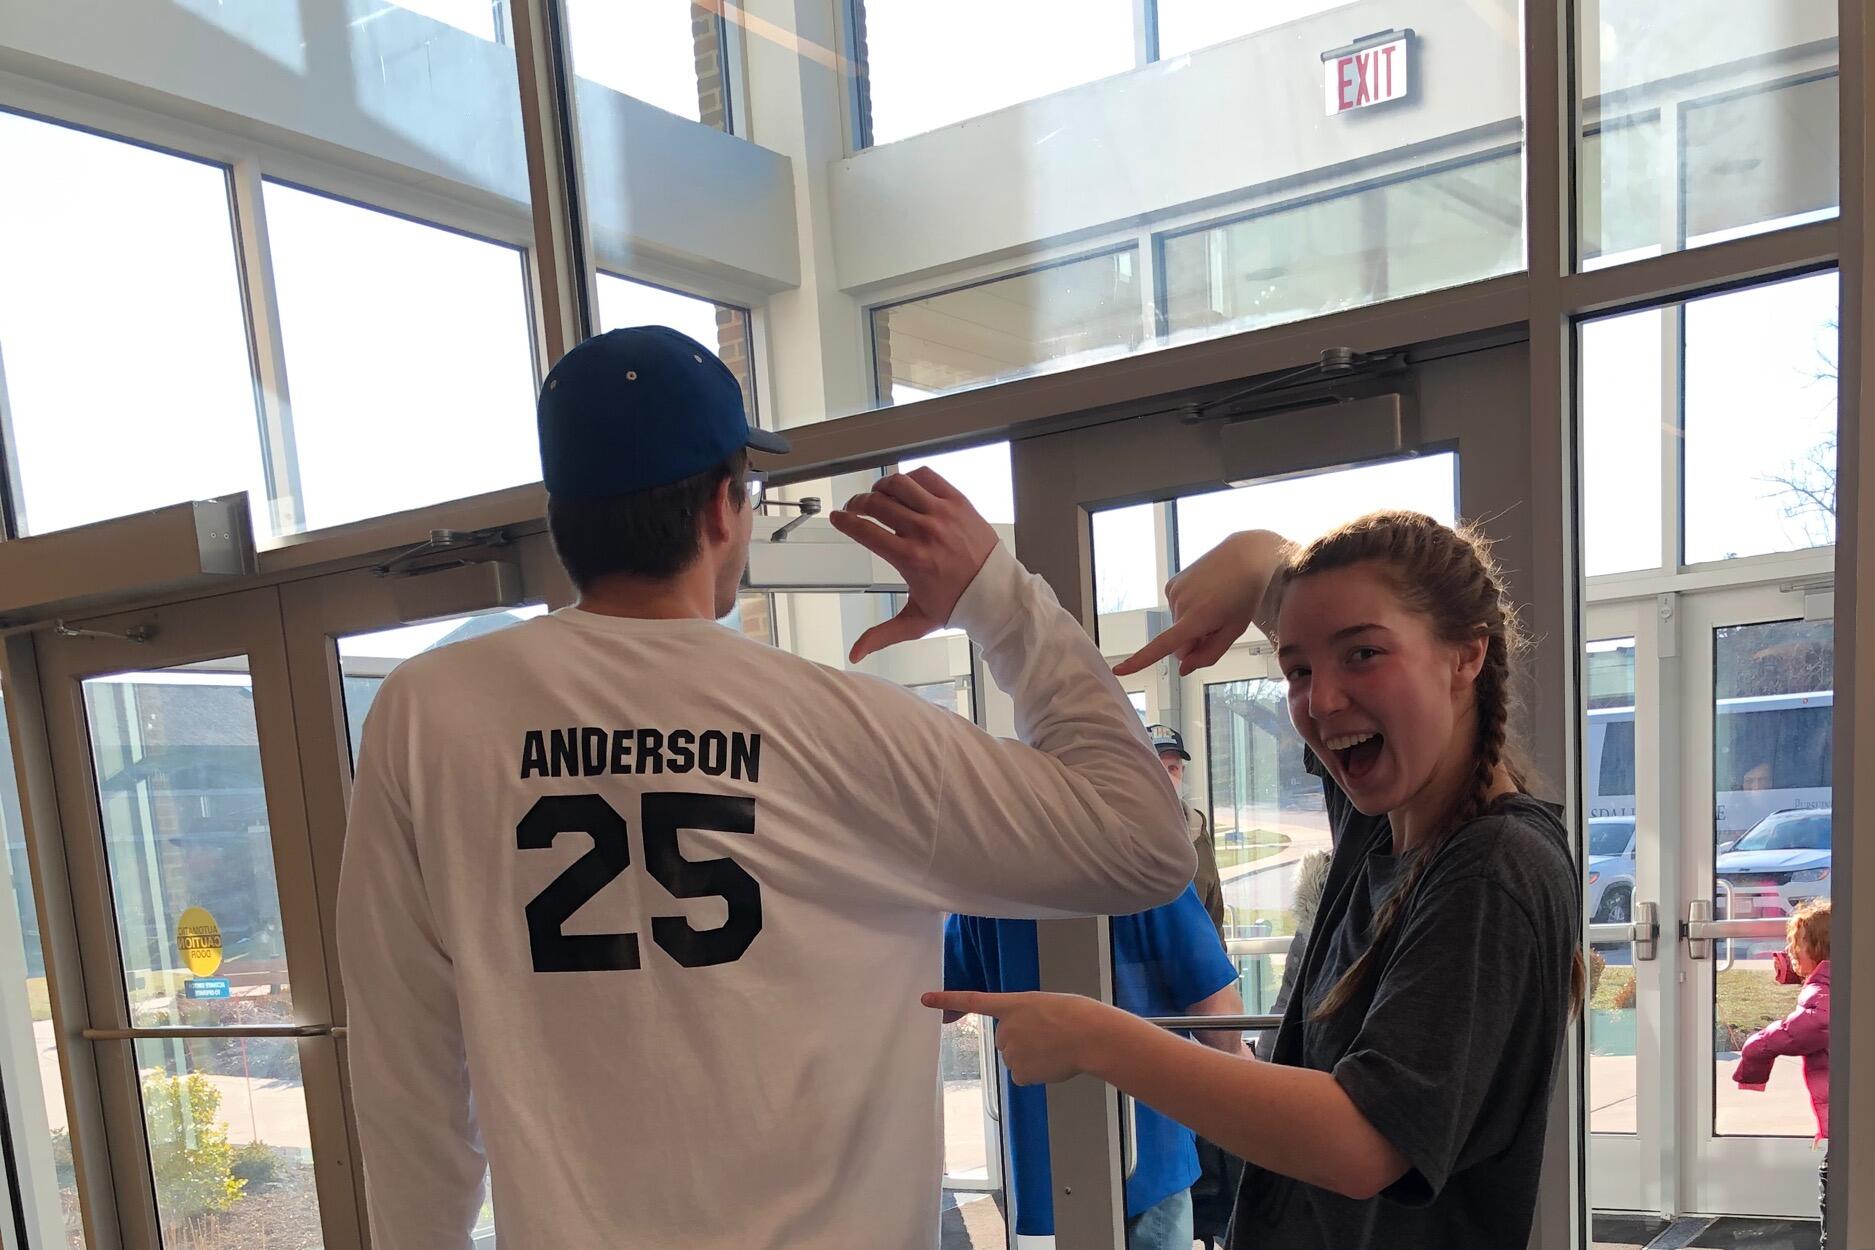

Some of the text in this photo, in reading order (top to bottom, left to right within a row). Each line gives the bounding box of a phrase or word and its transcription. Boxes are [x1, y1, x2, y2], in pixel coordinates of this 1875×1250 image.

[1337, 46, 1396, 110] EXIT
[520, 727, 761, 783] ANDERSON
[516, 792, 763, 973] 25
